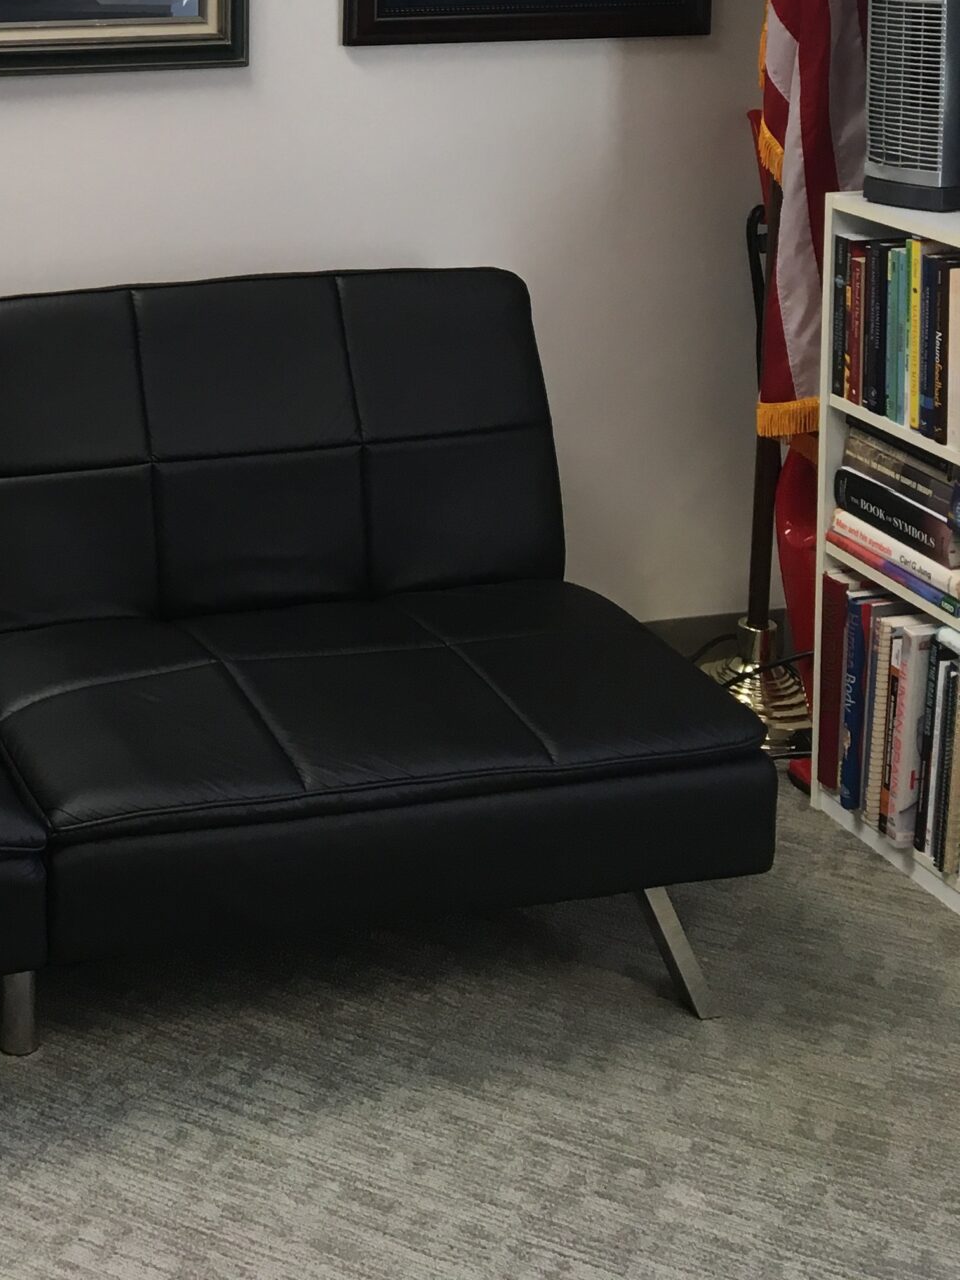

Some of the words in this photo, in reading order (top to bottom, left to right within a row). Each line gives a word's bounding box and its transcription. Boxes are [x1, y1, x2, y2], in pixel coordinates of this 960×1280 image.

[934, 330, 943, 408] Neurofeedback
[860, 499, 886, 521] BOOK
[892, 518, 936, 548] SYMBOLS
[899, 555, 912, 566] Carl
[917, 564, 933, 580] Jung
[844, 673, 857, 713] Body
[926, 681, 934, 707] BRAIN
